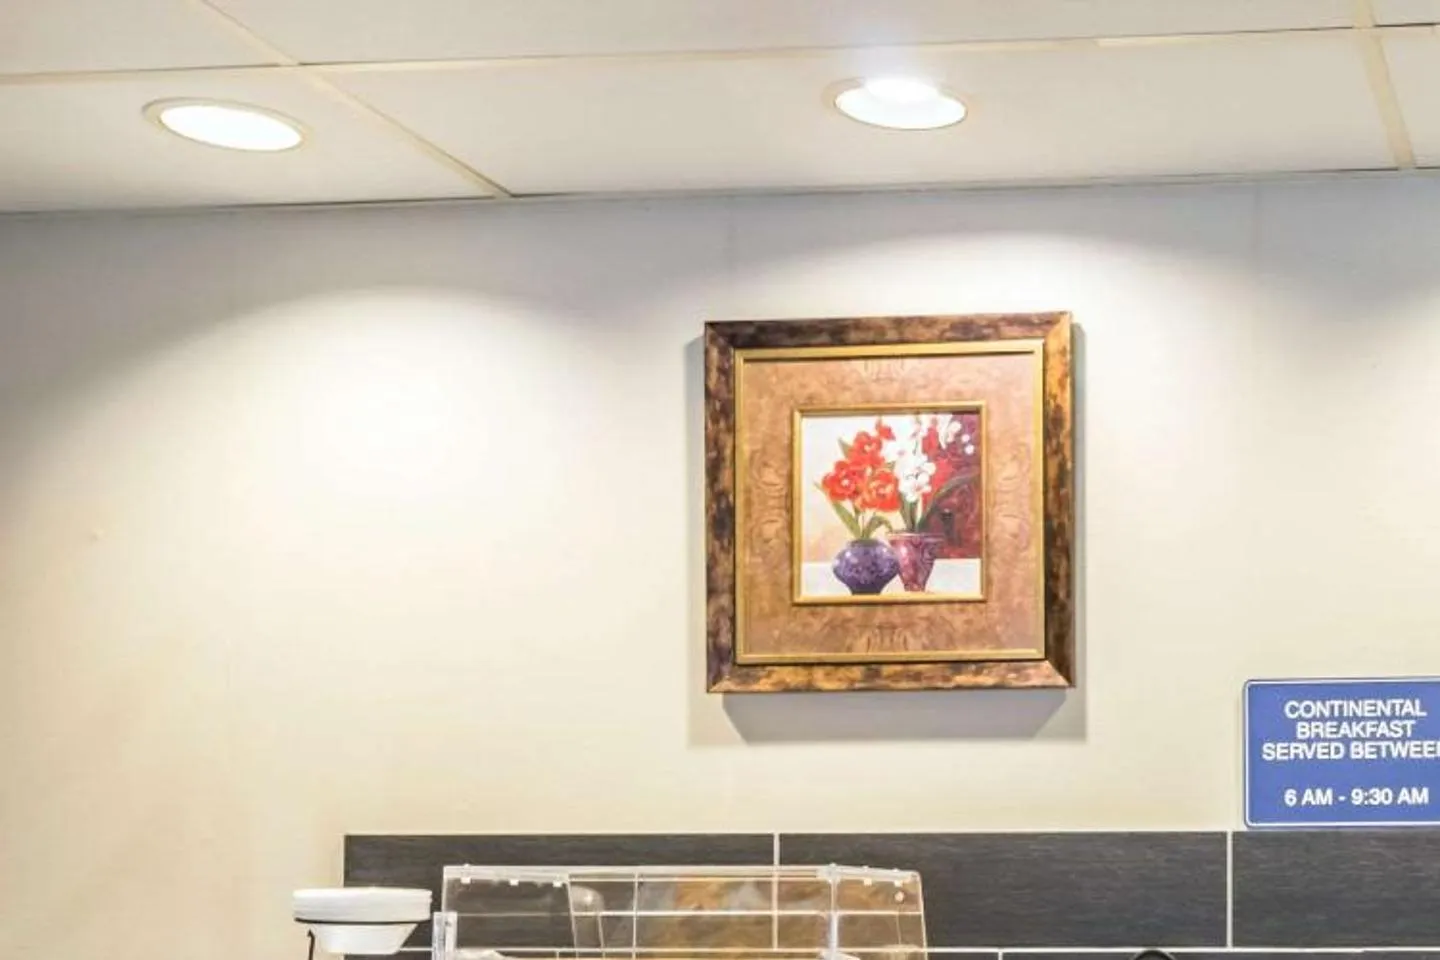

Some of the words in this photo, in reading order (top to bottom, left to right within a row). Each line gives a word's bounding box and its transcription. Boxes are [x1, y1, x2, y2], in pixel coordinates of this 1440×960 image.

[1284, 699, 1427, 719] CONTINENTAL
[1296, 720, 1416, 739] BREAKFAST
[1262, 742, 1345, 761] SERVED
[1284, 789, 1297, 806] 6
[1301, 789, 1333, 805] AM
[1351, 788, 1393, 806] 9:30
[1397, 788, 1429, 804] AM
